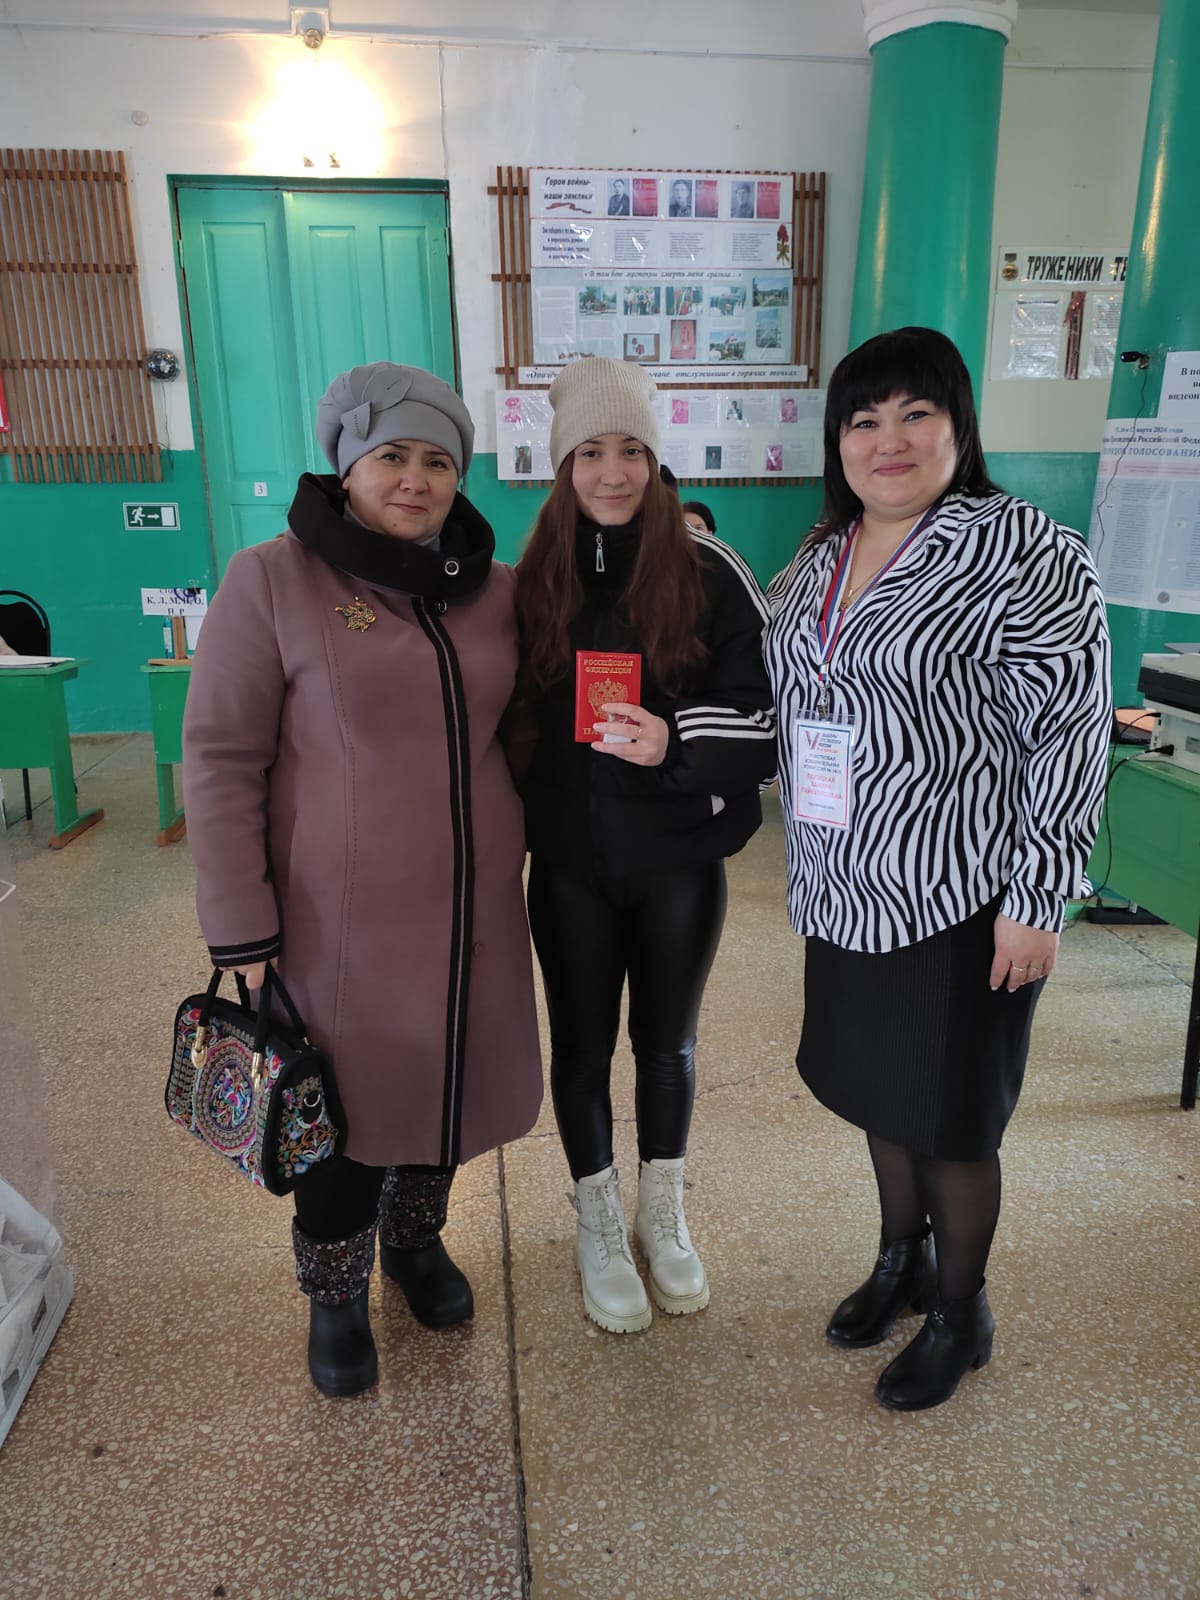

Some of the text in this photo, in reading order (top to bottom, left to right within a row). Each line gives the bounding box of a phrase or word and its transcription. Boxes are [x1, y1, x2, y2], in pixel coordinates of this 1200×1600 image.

[545, 177, 566, 186] Герои
[1027, 255, 1104, 281] ТРУЖЕНИКИ
[737, 371, 766, 379] горячих
[1181, 367, 1188, 376] В
[257, 484, 263, 495] 3
[583, 658, 633, 667] РОССИЙСКАЯ
[585, 666, 632, 674] ФЕДЕРАЦИЯ
